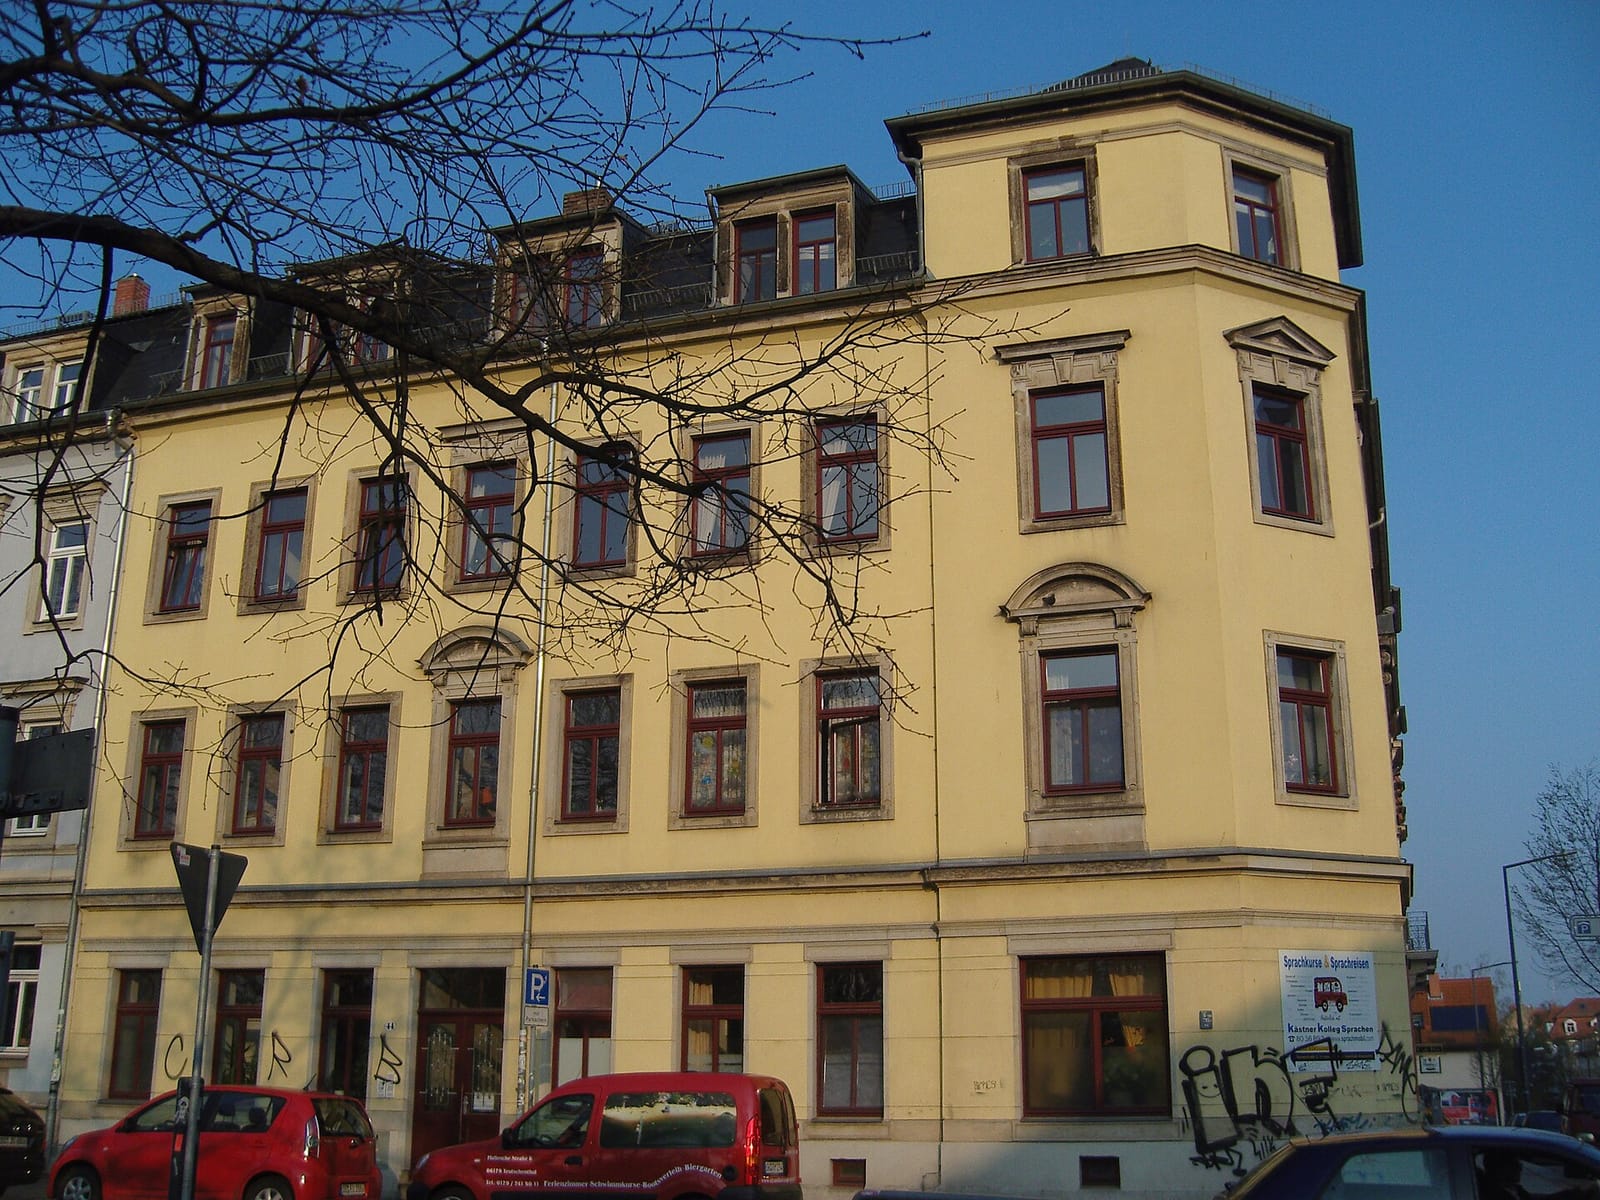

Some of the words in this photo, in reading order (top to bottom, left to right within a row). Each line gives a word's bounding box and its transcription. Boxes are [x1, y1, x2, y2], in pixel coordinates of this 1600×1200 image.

[1283, 955, 1322, 970] Sprachkurse
[1323, 954, 1329, 968] &
[1330, 956, 1370, 971] Sprachreisen
[531, 973, 544, 1000] P
[1317, 1022, 1340, 1034] Kolleg
[1341, 1025, 1374, 1034] Sprachen
[543, 1180, 588, 1188] Ferienzimmer
[589, 1180, 640, 1188] Schwimmkurse
[642, 1165, 682, 1189] Bootsverleih
[684, 1162, 723, 1179] Biergarten
